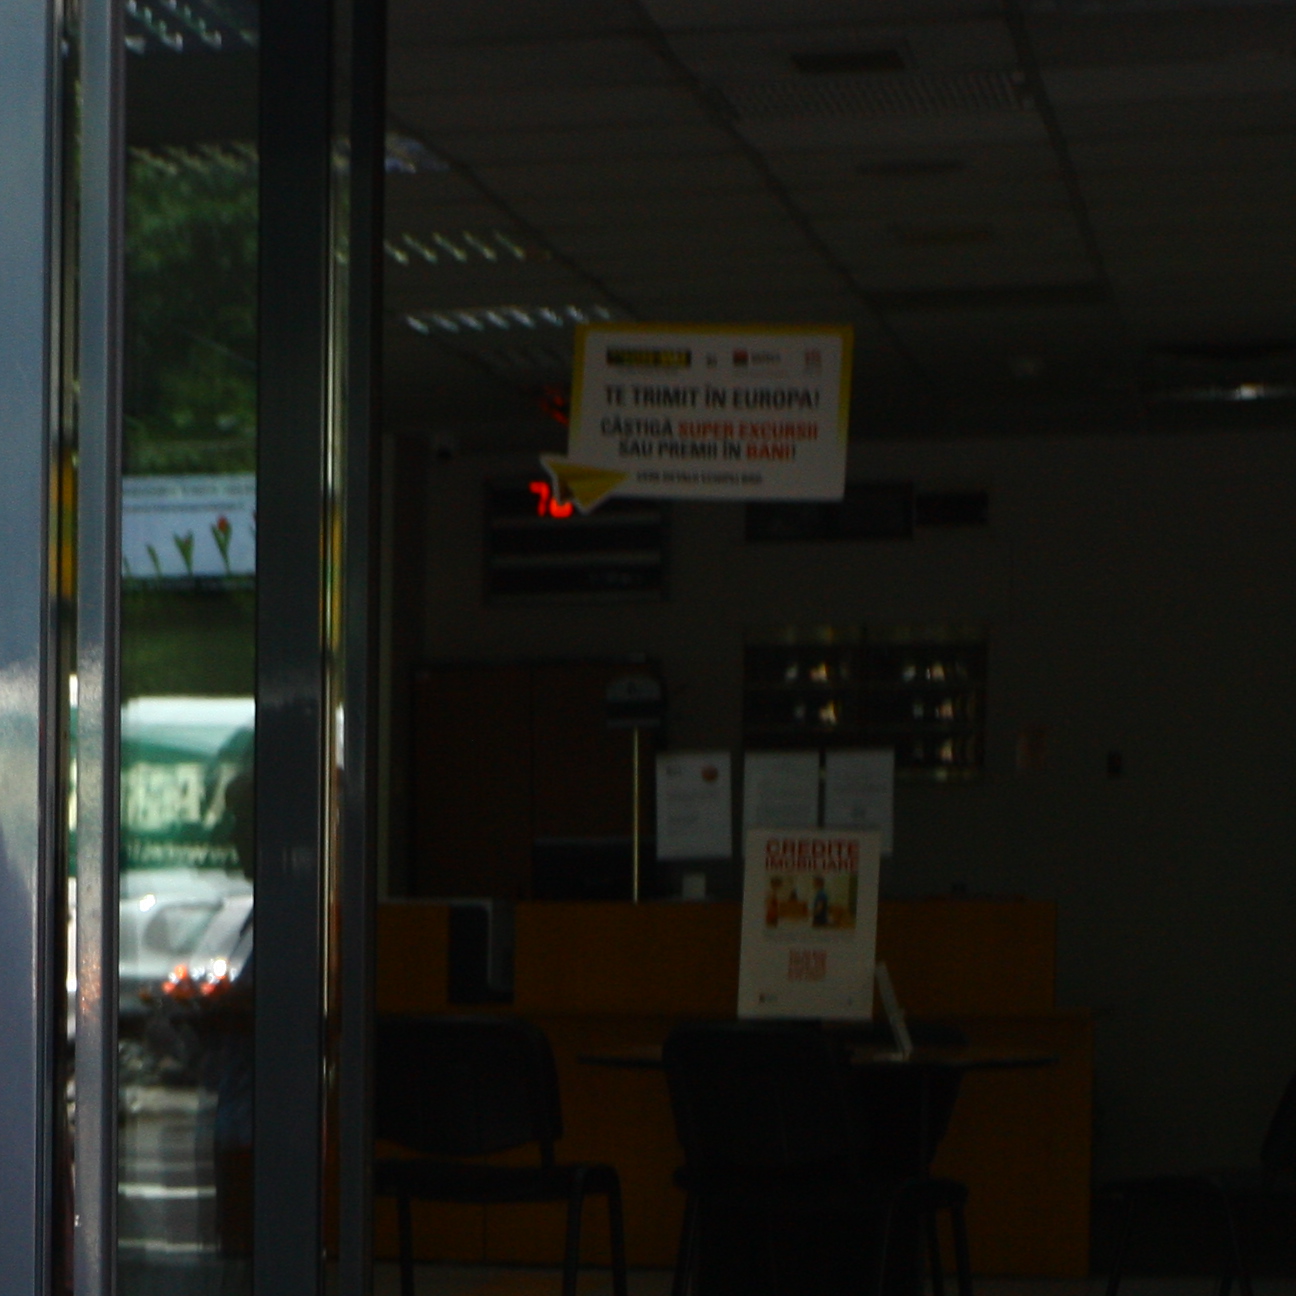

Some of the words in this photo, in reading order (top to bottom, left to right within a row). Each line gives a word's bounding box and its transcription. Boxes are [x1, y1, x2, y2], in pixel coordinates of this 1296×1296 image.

[604, 385, 624, 408] TE
[633, 385, 699, 409] TRIMIT
[733, 386, 821, 411] EUROPA!
[678, 419, 734, 440] SUPER
[738, 421, 819, 442] EXCURSII
[618, 439, 653, 458] SAU
[657, 441, 718, 460] PREMII
[765, 838, 860, 857] CREDITE
